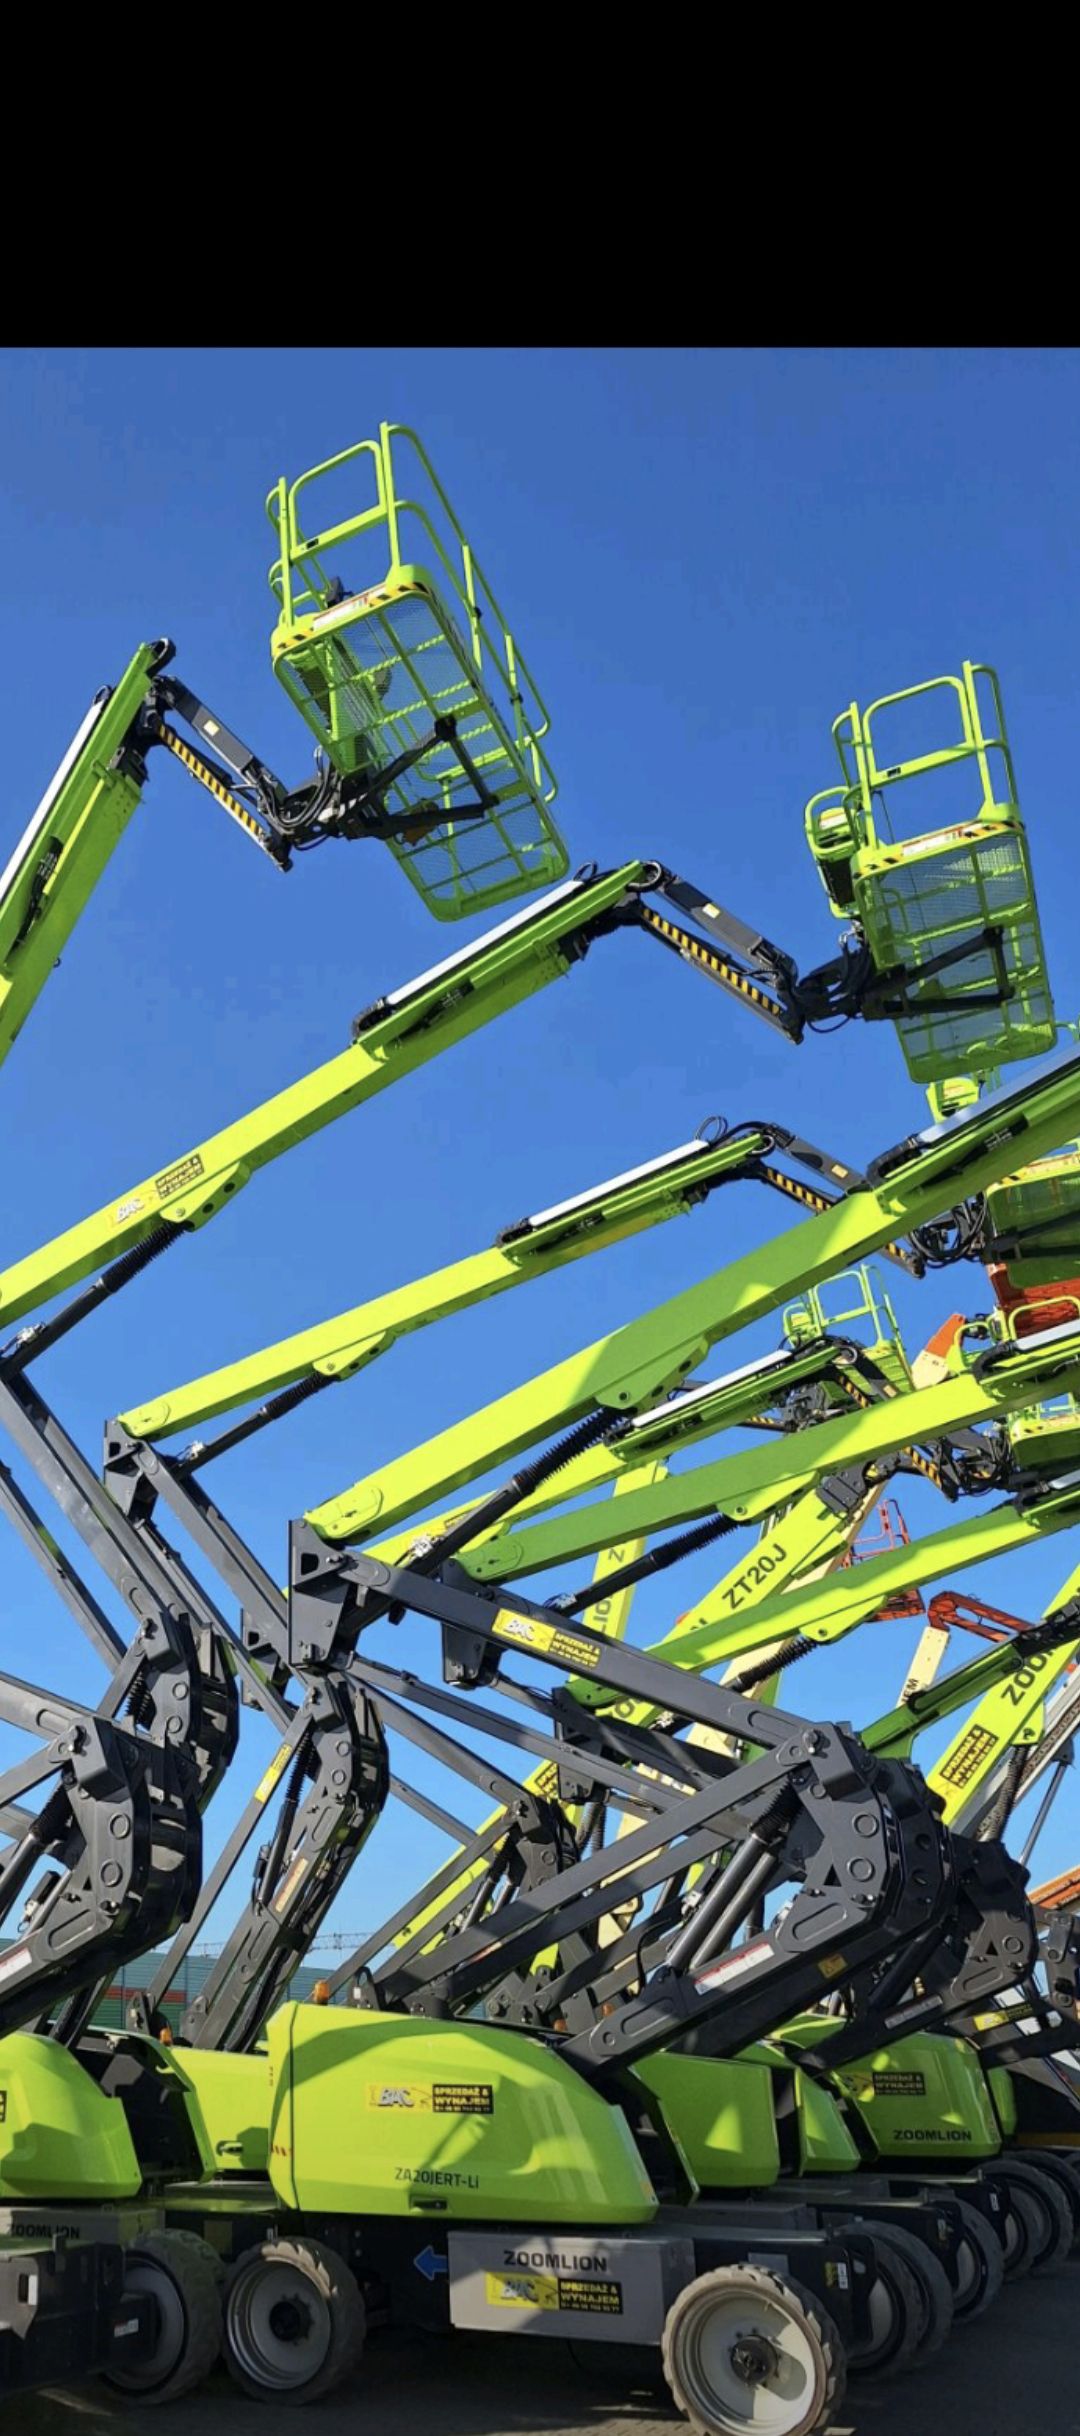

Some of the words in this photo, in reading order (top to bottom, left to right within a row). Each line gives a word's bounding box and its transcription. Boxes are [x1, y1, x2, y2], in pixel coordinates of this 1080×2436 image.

[722, 1543, 787, 1609] ZT20J
[378, 2086, 415, 2107] BAC
[435, 2096, 490, 2106] WYNAJEM
[893, 2129, 972, 2142] ZOOMLION
[503, 2250, 608, 2272] ZOOMLION
[561, 2292, 620, 2305] WYNAJEM
